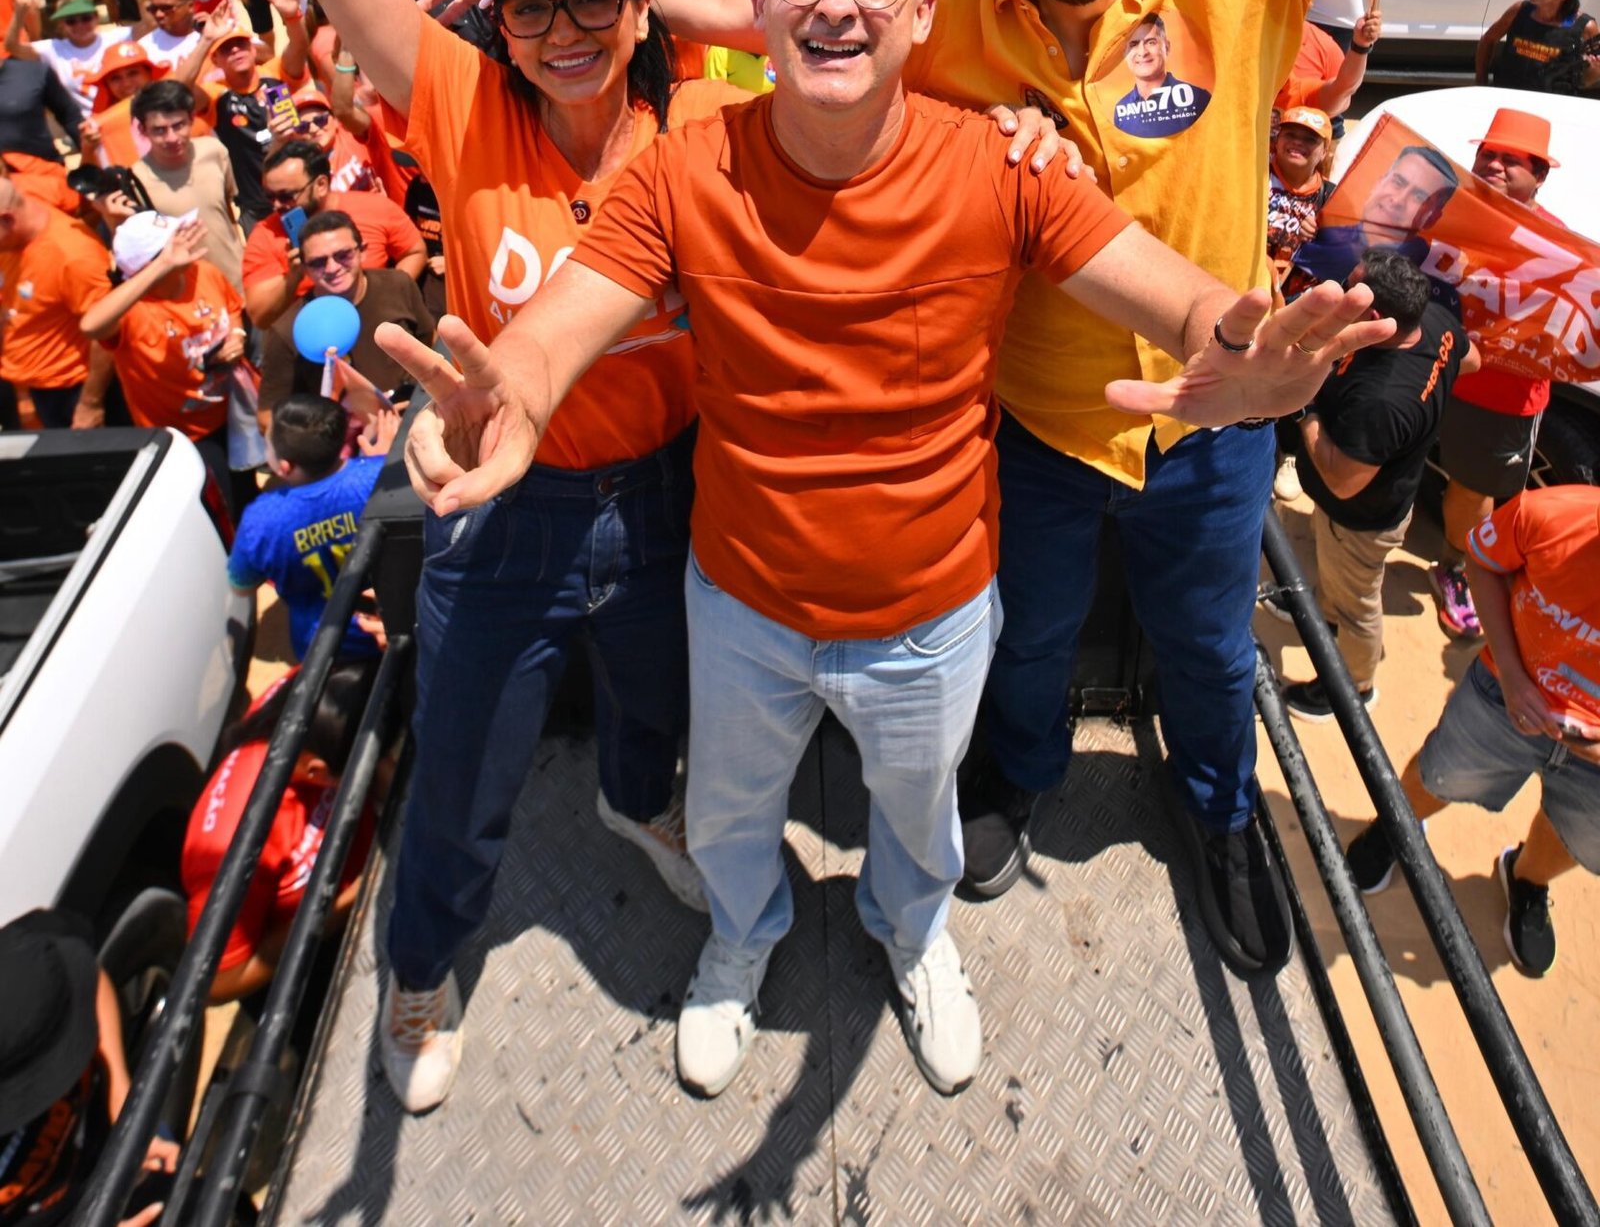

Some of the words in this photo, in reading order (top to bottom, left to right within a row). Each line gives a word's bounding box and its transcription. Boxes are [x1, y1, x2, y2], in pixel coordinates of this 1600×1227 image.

[1116, 100, 1158, 117] DAVID
[1151, 83, 1194, 110] 70
[1419, 238, 1600, 370] DAVID
[294, 512, 358, 553] BRASIL
